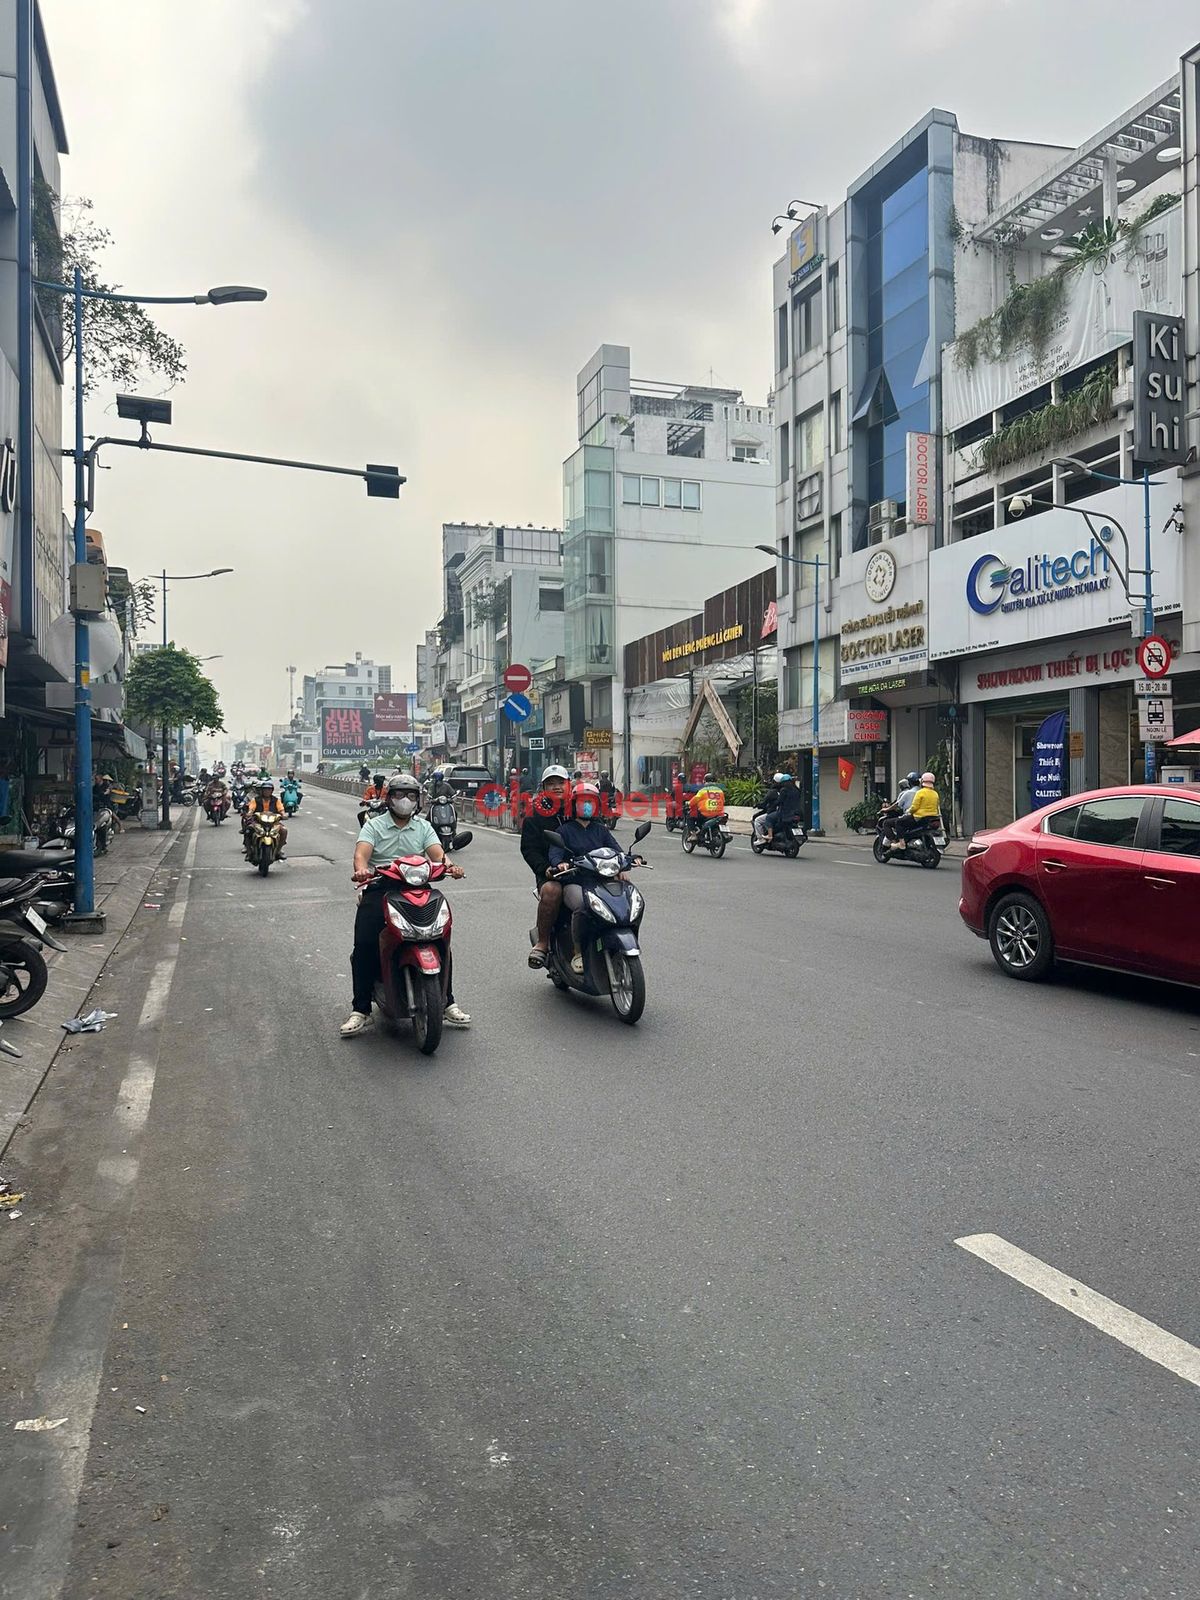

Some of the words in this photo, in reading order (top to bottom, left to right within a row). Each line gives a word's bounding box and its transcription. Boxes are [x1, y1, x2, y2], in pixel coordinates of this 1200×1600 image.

[1150, 322, 1178, 360] Ki
[1148, 372, 1182, 401] su
[1151, 410, 1179, 450] hi
[916, 435, 928, 485] DOCTOR
[916, 487, 928, 521] LASER
[841, 633, 887, 662] DOCTOR
[888, 625, 925, 651] LASER
[977, 664, 1043, 690] SHOWROOM
[1046, 651, 1082, 679] THIẾT
[1086, 654, 1100, 676] BỊ
[1103, 648, 1132, 673] LỌC
[325, 709, 360, 720] JUN
[325, 720, 362, 732] GER
[1036, 773, 1047, 784] Lọc
[1039, 757, 1054, 767] Thiết
